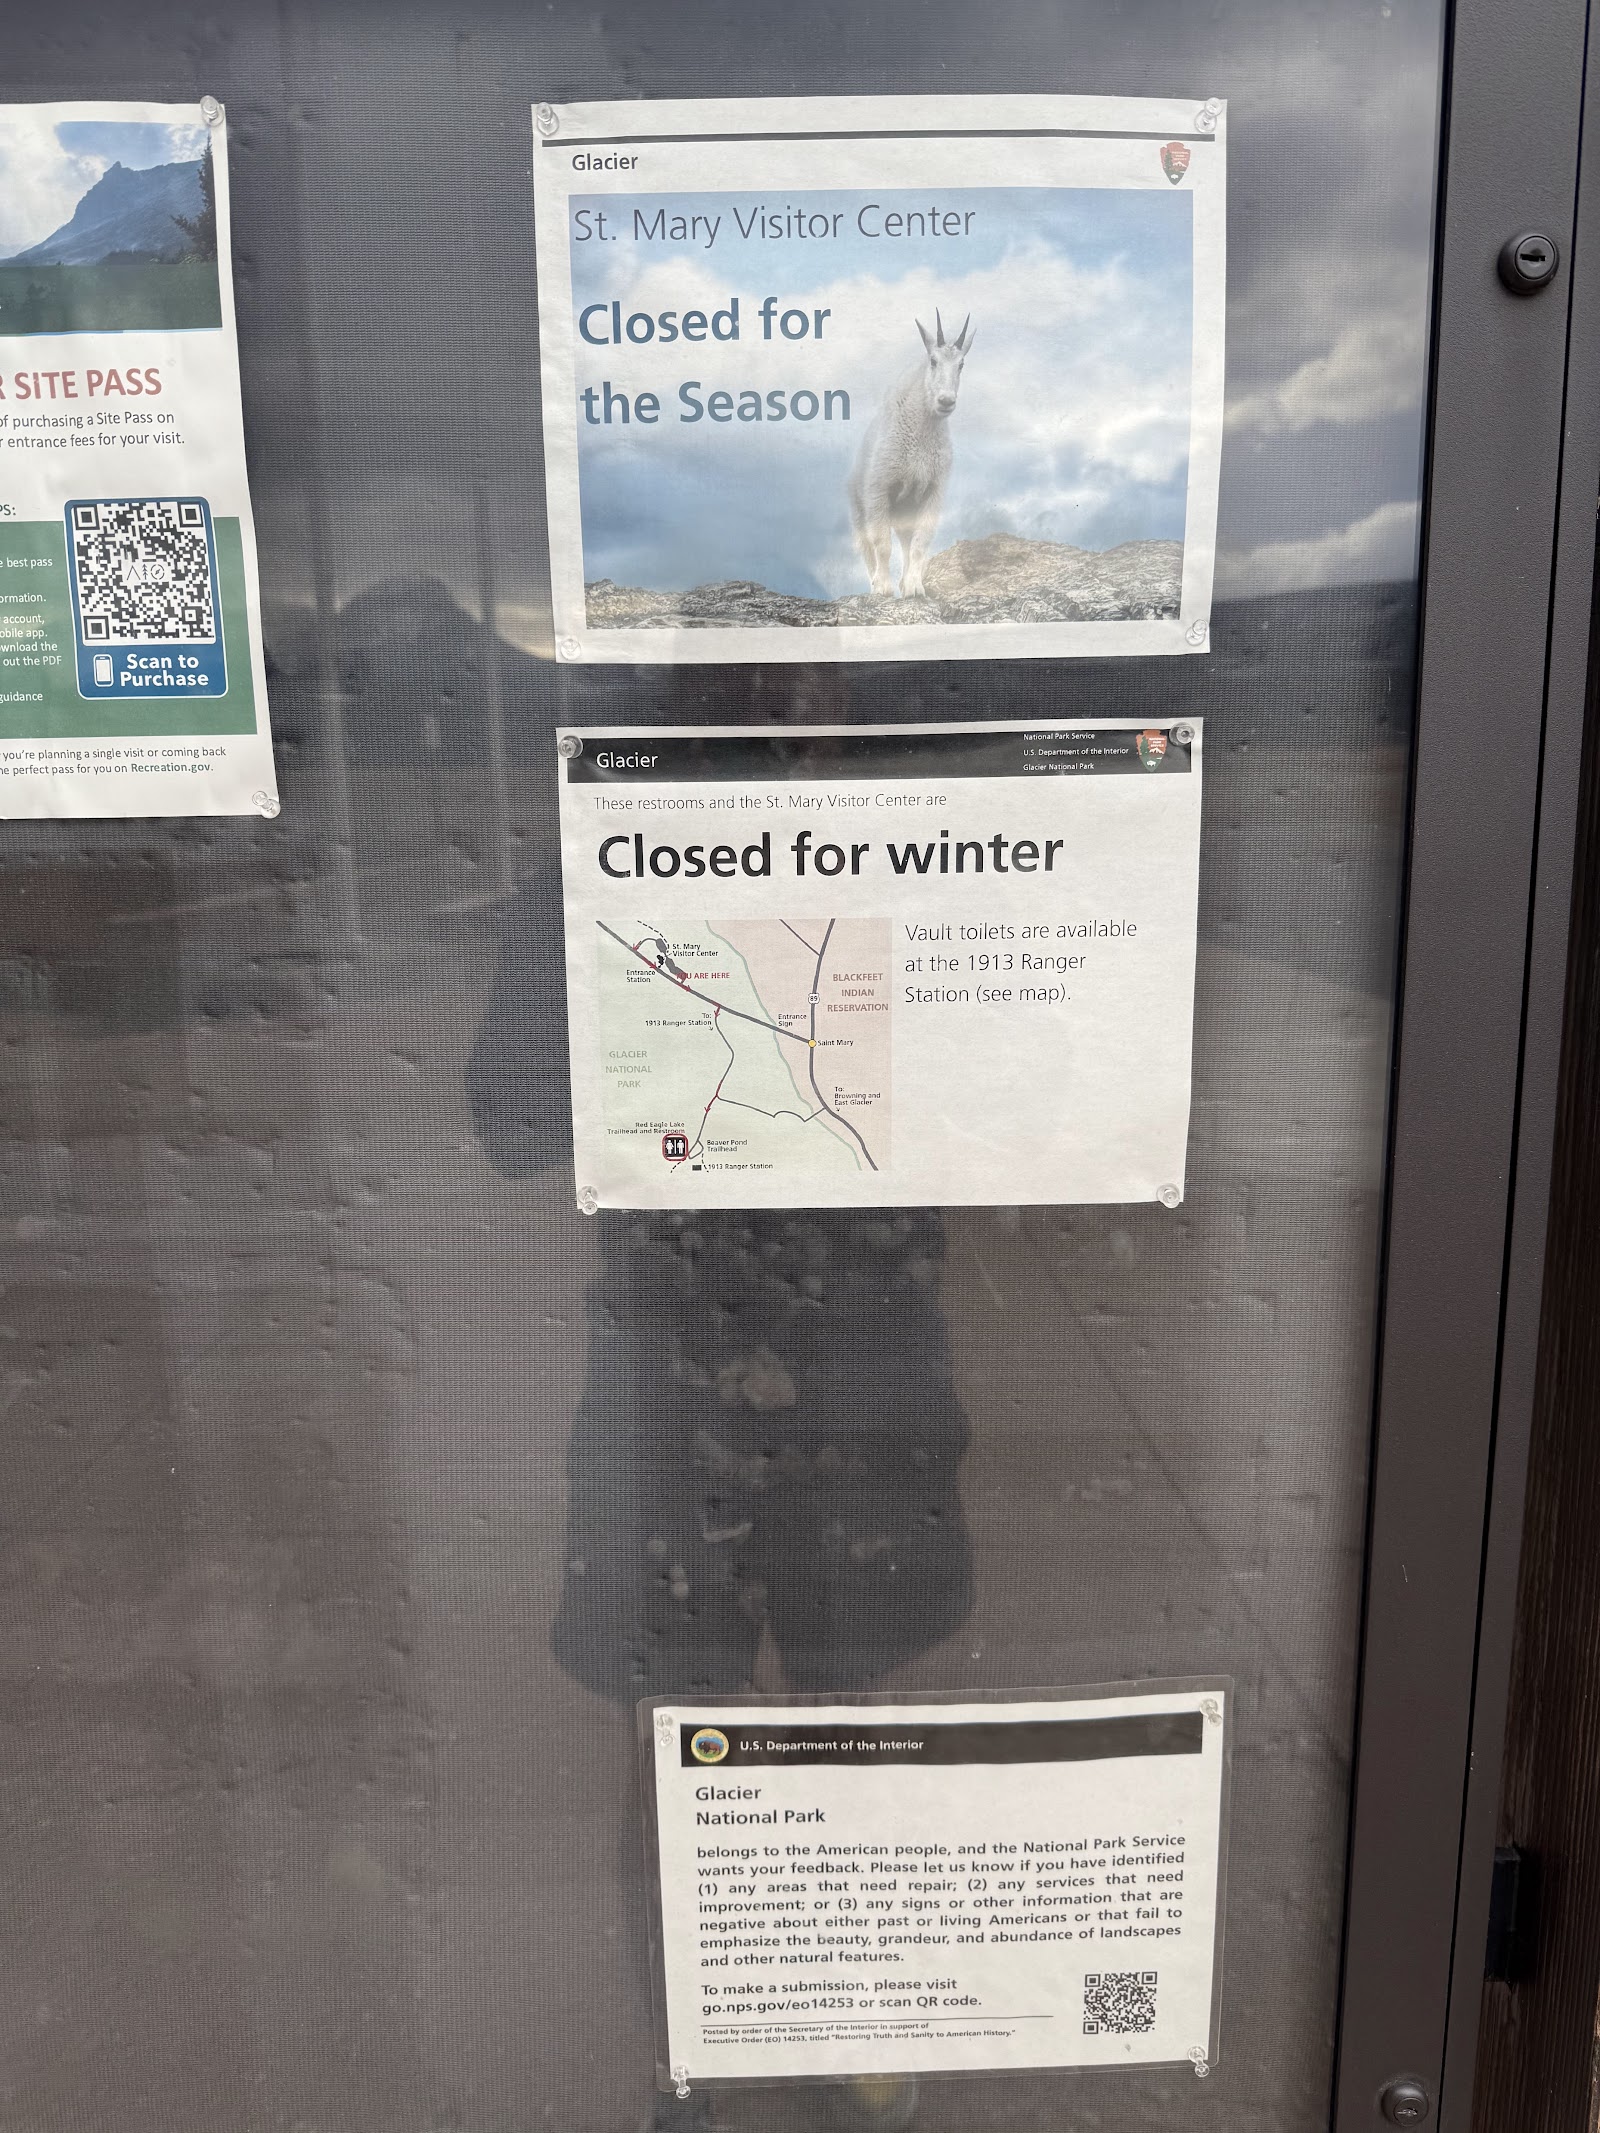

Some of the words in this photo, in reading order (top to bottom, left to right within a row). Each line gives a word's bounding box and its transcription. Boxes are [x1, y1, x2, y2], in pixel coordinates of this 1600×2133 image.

[572, 152, 638, 171] Glacier
[574, 209, 616, 241] St.
[634, 208, 722, 249] Mary
[732, 205, 844, 239] Visitor
[857, 204, 976, 237] Center
[578, 297, 740, 345] Closed
[758, 296, 831, 340] for
[14, 370, 78, 400] SITE
[86, 368, 162, 397] PASS
[580, 381, 661, 425] the
[678, 381, 850, 423] Season
[12, 414, 84, 430] purchasing
[87, 415, 94, 426] a
[96, 412, 120, 425] Site
[124, 411, 153, 424] Pass
[157, 413, 174, 424] on
[7, 436, 67, 448] entrance
[70, 434, 95, 447] fees
[97, 432, 117, 446] for
[119, 434, 150, 448] your
[152, 431, 185, 444] visit.
[6, 557, 28, 568] best
[30, 558, 53, 569] pass
[3, 614, 45, 628] account,
[26, 630, 48, 639] app.
[40, 641, 58, 651] the
[2, 657, 20, 667] out
[22, 655, 40, 666] the
[42, 655, 62, 665] PDF
[126, 654, 173, 670] Scan
[177, 654, 199, 668] to
[121, 671, 210, 688] Purchase
[38, 749, 82, 761] planning
[92, 748, 121, 760] single
[123, 747, 144, 758] visit
[147, 749, 159, 757] or
[161, 747, 200, 759] coming
[202, 746, 226, 756] back
[1038, 749, 1080, 757] Department
[1080, 747, 1089, 755] of
[1104, 747, 1129, 755] Interior
[596, 752, 658, 769] Glacier
[1022, 763, 1047, 771] Glacier
[1079, 762, 1094, 770] Park
[12, 764, 49, 777] perfect
[51, 766, 74, 776] pass
[76, 763, 91, 774] for
[93, 766, 112, 775] you
[114, 765, 128, 773] on
[131, 762, 214, 774] Recreation.gov.
[593, 796, 633, 810] These
[638, 798, 705, 810] restrooms
[709, 795, 735, 809] and
[739, 795, 762, 809] the
[766, 795, 783, 809] St.
[789, 795, 823, 811] Mary
[827, 794, 870, 807] Visitor
[875, 793, 921, 807] Center
[926, 795, 947, 806] are
[598, 832, 771, 878] Closed
[790, 830, 870, 876] for
[886, 830, 1064, 874] winter
[905, 923, 952, 941] Vault
[959, 922, 1015, 940] toilets
[1021, 926, 1050, 939] are
[1056, 919, 1137, 938] available
[905, 957, 923, 972] at
[929, 954, 959, 972] the
[968, 953, 1013, 971] 1913
[1022, 953, 1086, 974] Ranger
[626, 968, 657, 976] Entrance
[833, 973, 883, 982] BLACKFEET
[809, 995, 819, 1003] 89
[841, 988, 874, 997] INDIAN
[905, 985, 969, 1003] Station
[976, 984, 1012, 1004] (see
[1019, 983, 1071, 1005] map).
[827, 1003, 888, 1012] RESERVATION
[688, 1019, 712, 1027] Station
[778, 1013, 807, 1021] Entrance
[778, 1020, 793, 1028] Sign
[608, 1050, 648, 1059] GLACIER
[605, 1065, 652, 1074] NATIONAL
[617, 1080, 641, 1088] PARK
[834, 1093, 866, 1101] Browning
[706, 1139, 730, 1147] Beaver
[730, 1139, 748, 1147] Pond
[740, 1740, 763, 1751] U.S.
[766, 1741, 838, 1753] Department
[840, 1740, 853, 1751] of
[856, 1740, 876, 1751] the
[880, 1740, 924, 1750] Interior
[695, 1786, 762, 1801] Glacier
[696, 1809, 777, 1825] National
[784, 1808, 826, 1823] Park
[697, 1846, 758, 1860] belongs
[763, 1846, 780, 1856] to
[785, 1844, 810, 1856] the
[816, 1843, 888, 1855] American
[895, 1843, 951, 1857] people,
[958, 1843, 986, 1854] and
[992, 1842, 1017, 1854] the
[1024, 1838, 1087, 1853] National
[1094, 1836, 1126, 1849] Park
[1132, 1834, 1186, 1847] Service
[700, 1954, 728, 1967] and
[734, 1953, 775, 1966] other
[780, 1951, 833, 1964] natural
[838, 1951, 904, 1962] features.
[702, 1997, 854, 2016] go.nps.gov/eo14253
[859, 1999, 875, 2008] or
[879, 1998, 911, 2007] scan
[916, 1996, 938, 2008] QR
[943, 1995, 982, 2006] code.
[730, 2028, 740, 2036] by
